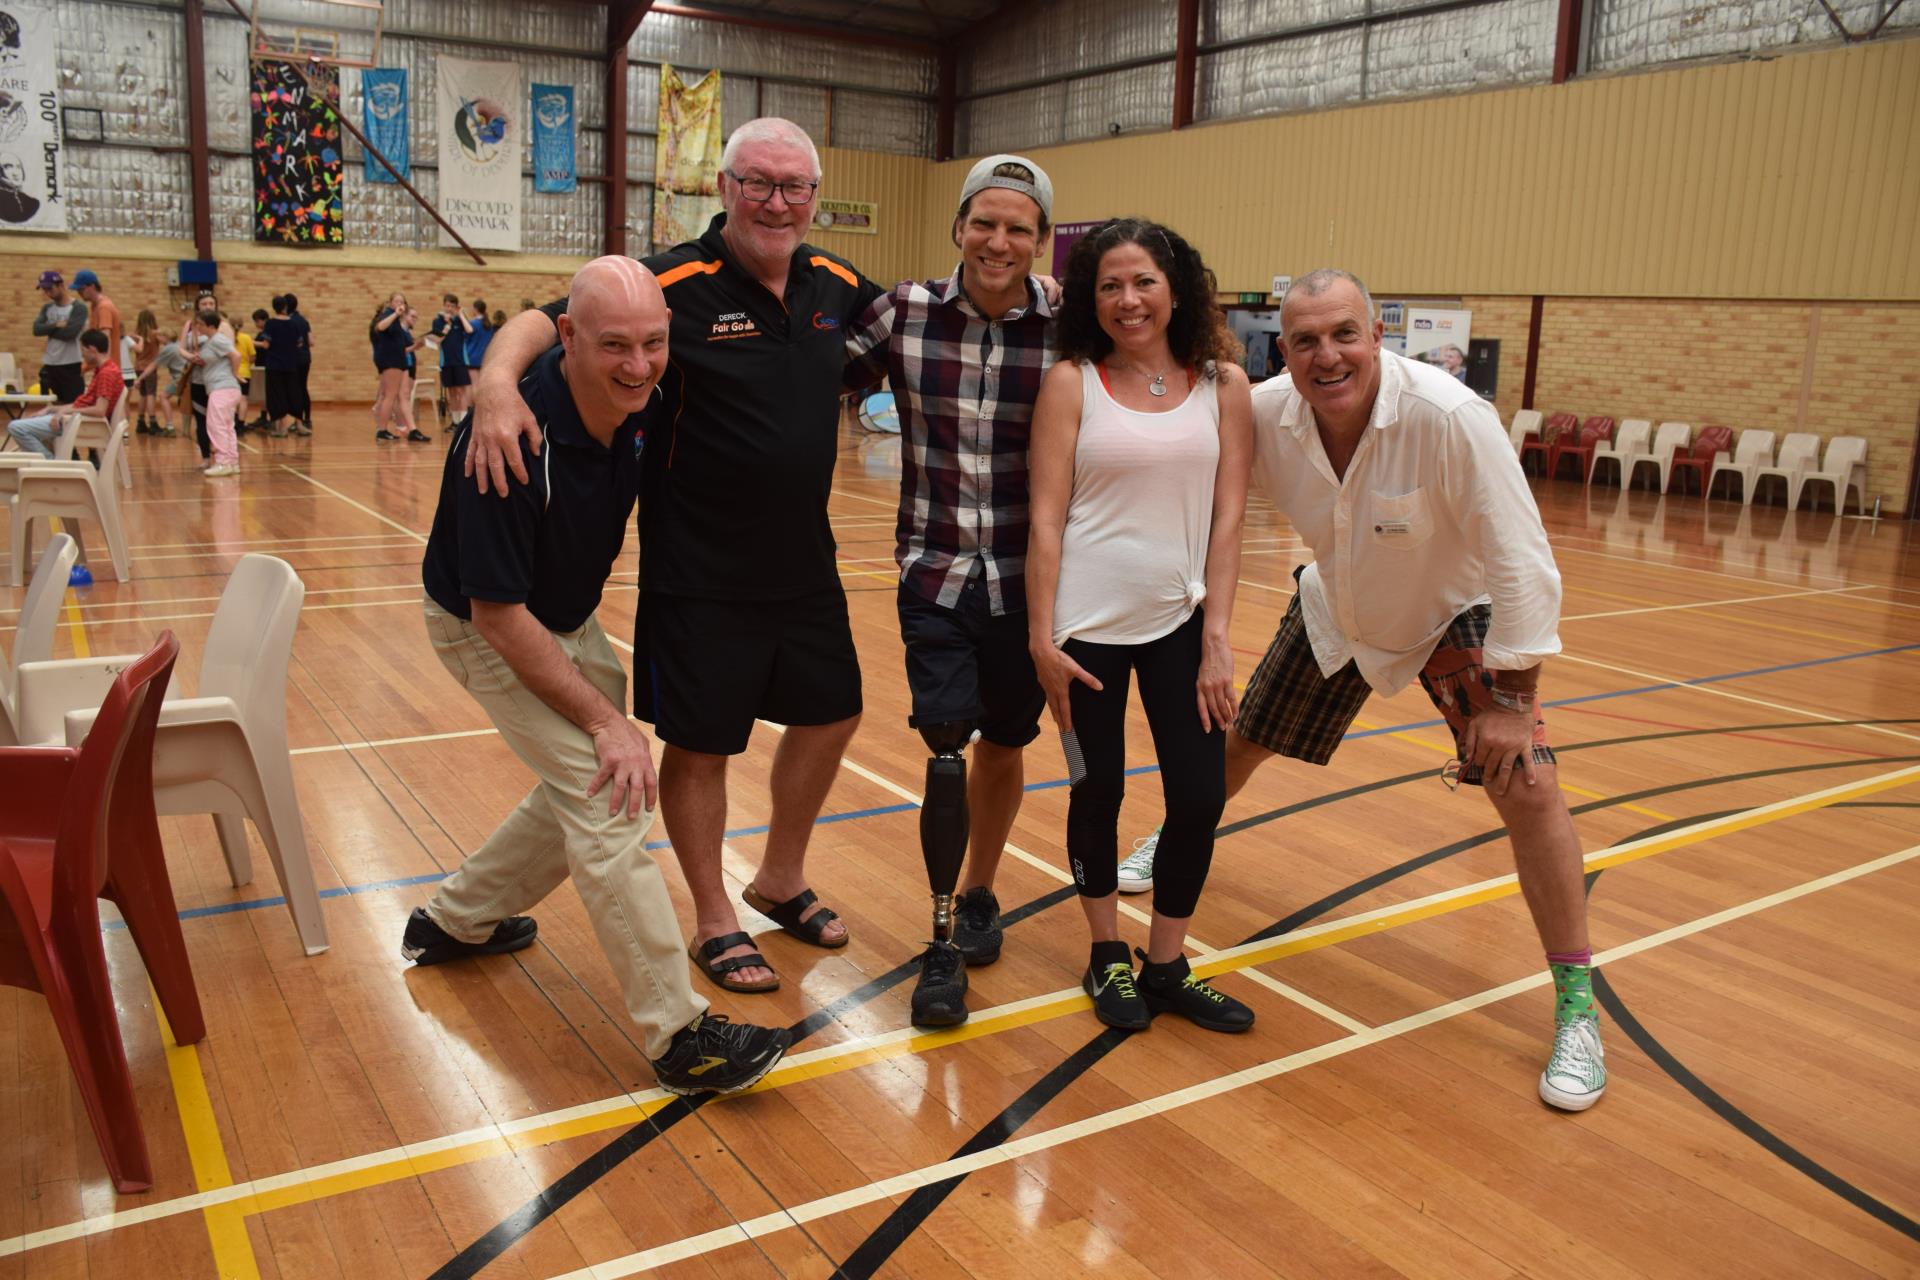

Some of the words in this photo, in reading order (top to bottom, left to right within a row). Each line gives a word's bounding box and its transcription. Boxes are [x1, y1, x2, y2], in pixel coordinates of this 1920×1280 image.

[39, 90, 57, 122] 100
[43, 142, 62, 204] Denmark
[446, 198, 513, 217] DISCOVER
[449, 213, 511, 231] DENMARK
[1274, 281, 1290, 291] EXIT
[719, 312, 746, 321] DERECK
[713, 323, 730, 333] Fair
